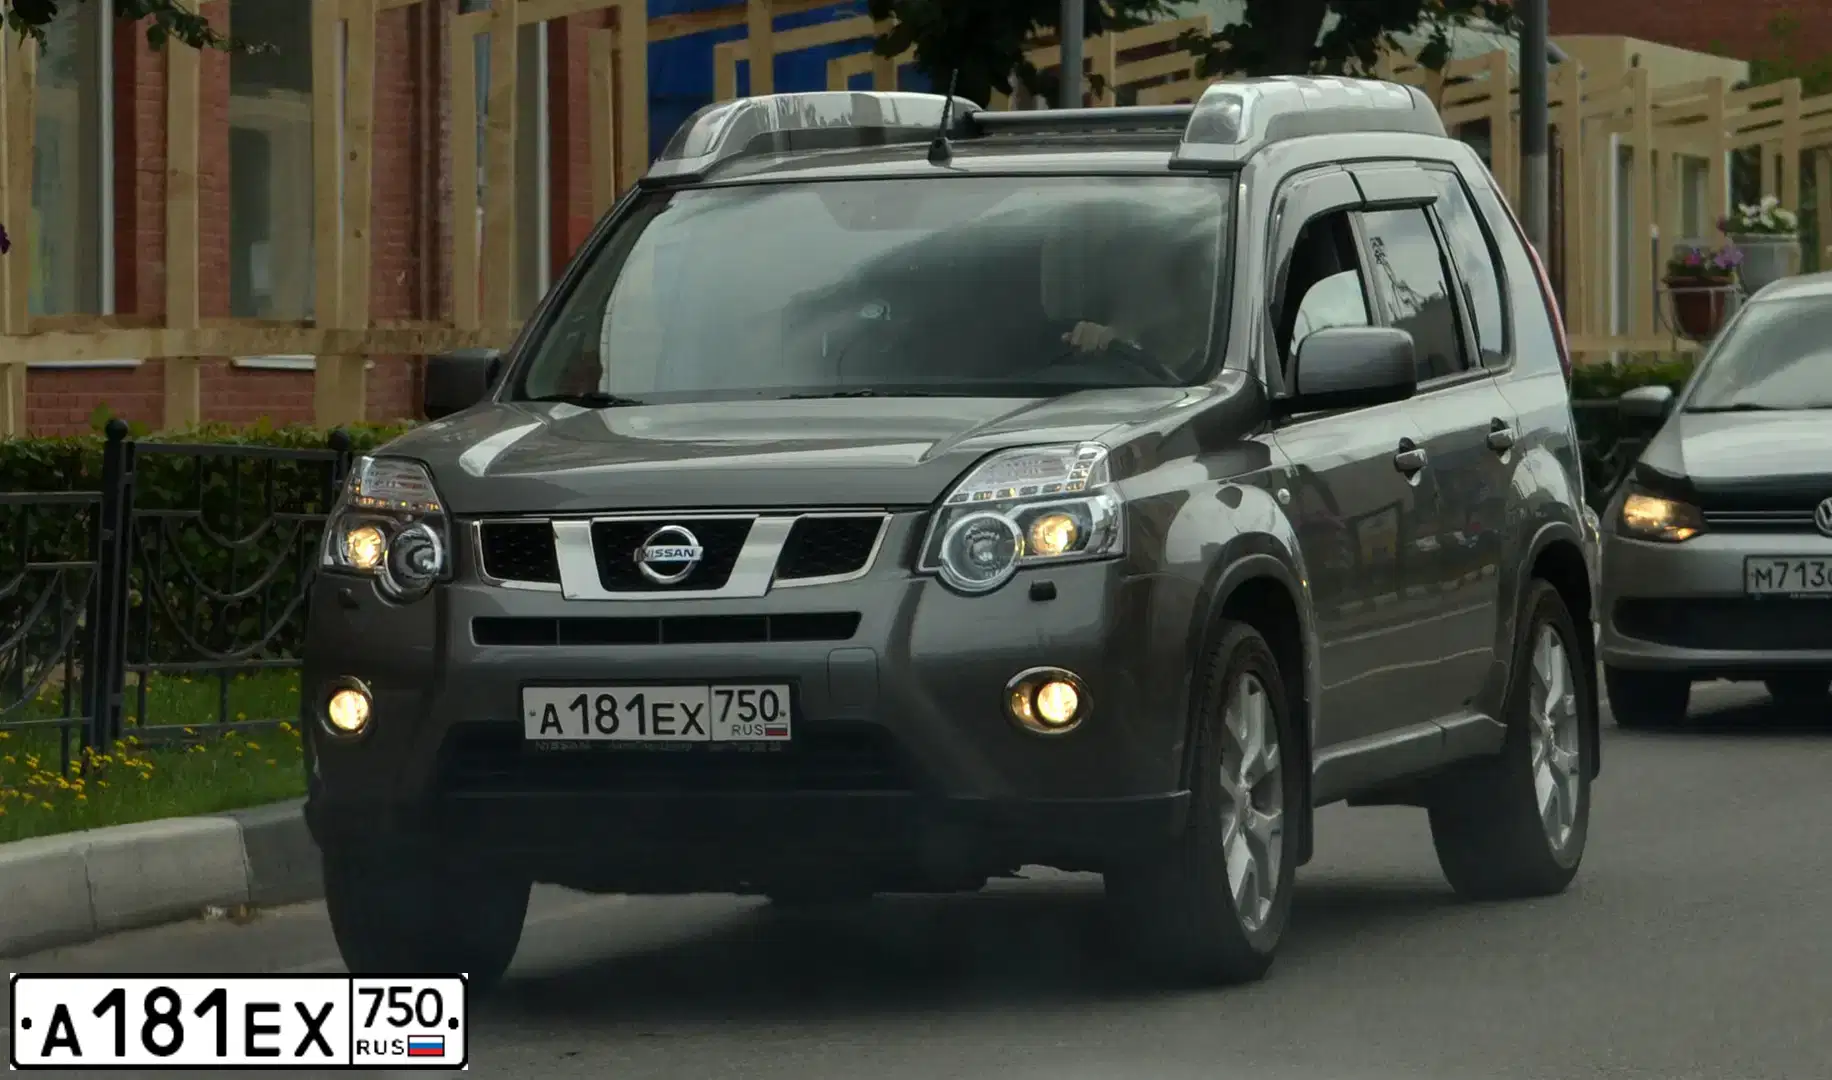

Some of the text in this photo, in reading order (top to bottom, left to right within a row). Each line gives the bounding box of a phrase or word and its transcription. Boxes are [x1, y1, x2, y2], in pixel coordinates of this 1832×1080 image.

[644, 548, 695, 558] NISSAN
[540, 689, 779, 736] А181ЕХ 750
[731, 724, 763, 736] RUS
